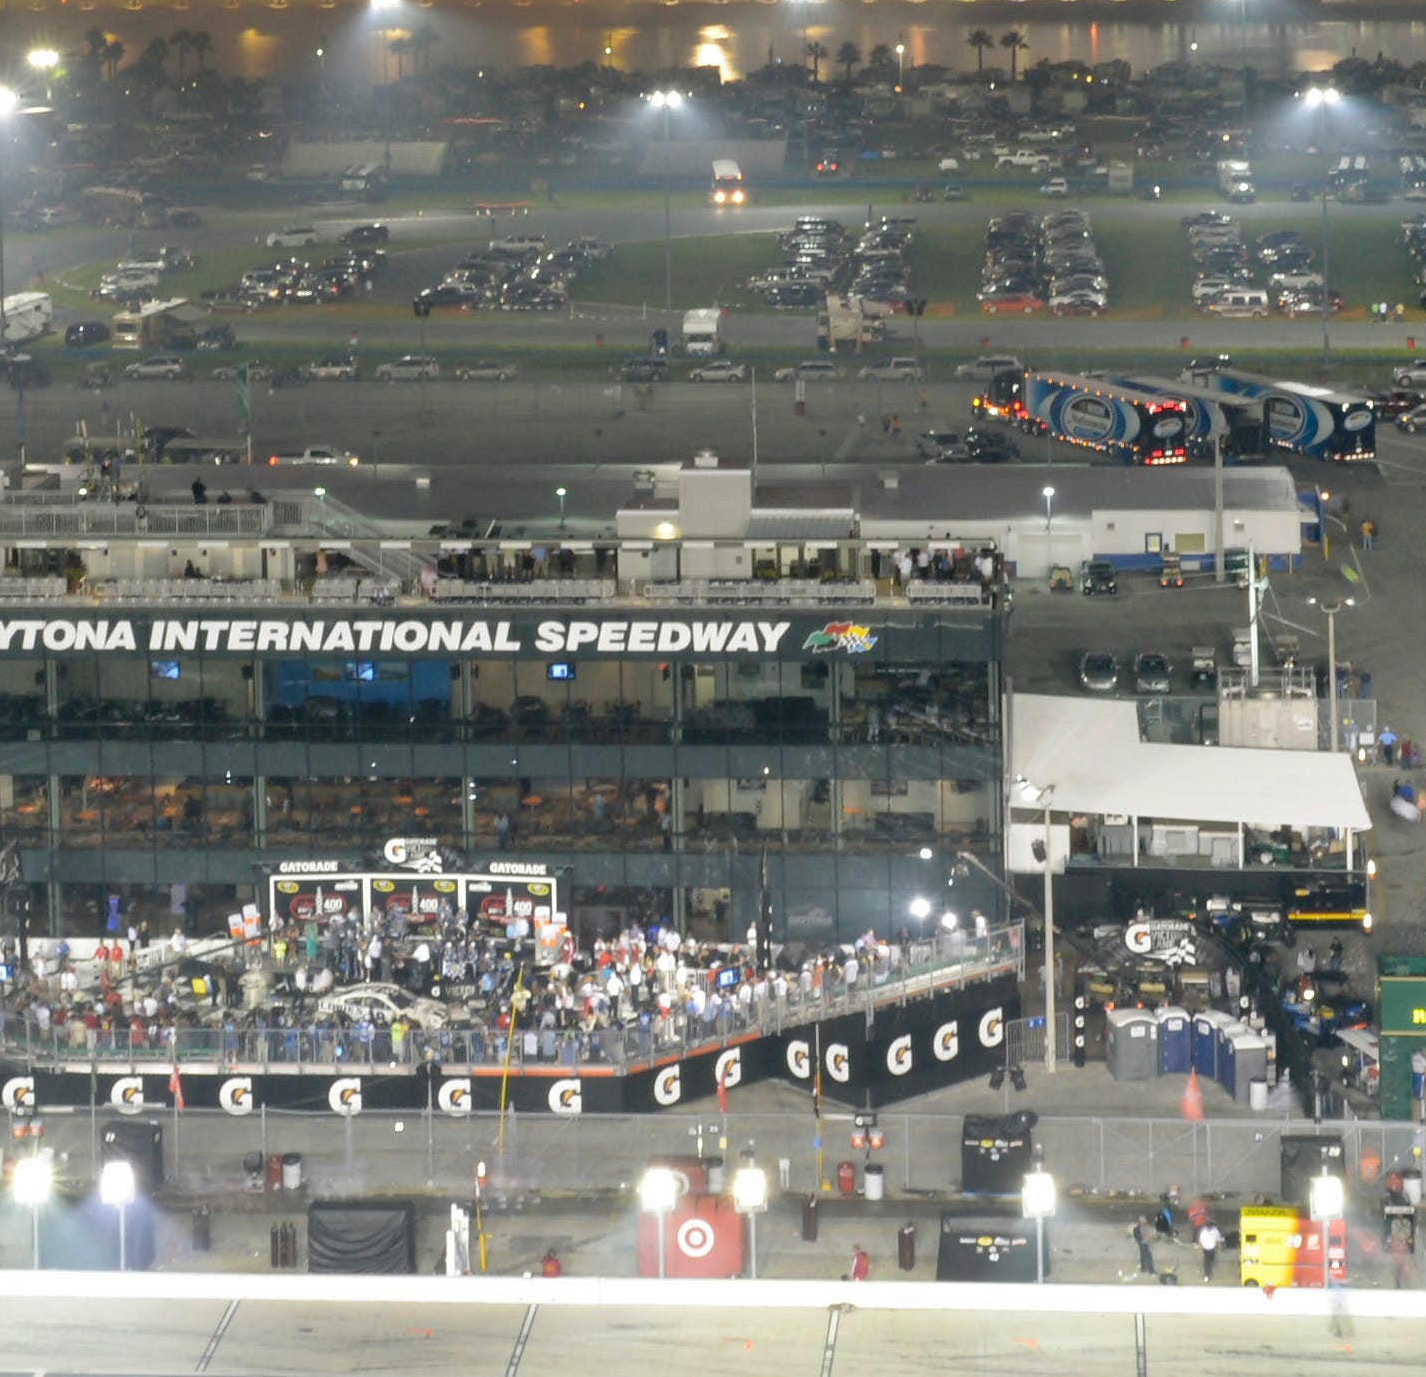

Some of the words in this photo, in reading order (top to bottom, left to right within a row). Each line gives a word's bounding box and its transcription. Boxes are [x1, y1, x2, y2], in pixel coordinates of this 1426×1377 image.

[148, 620, 521, 652] INTERNATIONAL
[534, 621, 791, 652] SPEEDWAY
[279, 861, 338, 872] GATORADE
[489, 862, 547, 875] GATORADE
[323, 898, 343, 912] 400
[419, 898, 438, 914] 400
[513, 901, 532, 917] 400
[1286, 1234, 1303, 1248] 20
